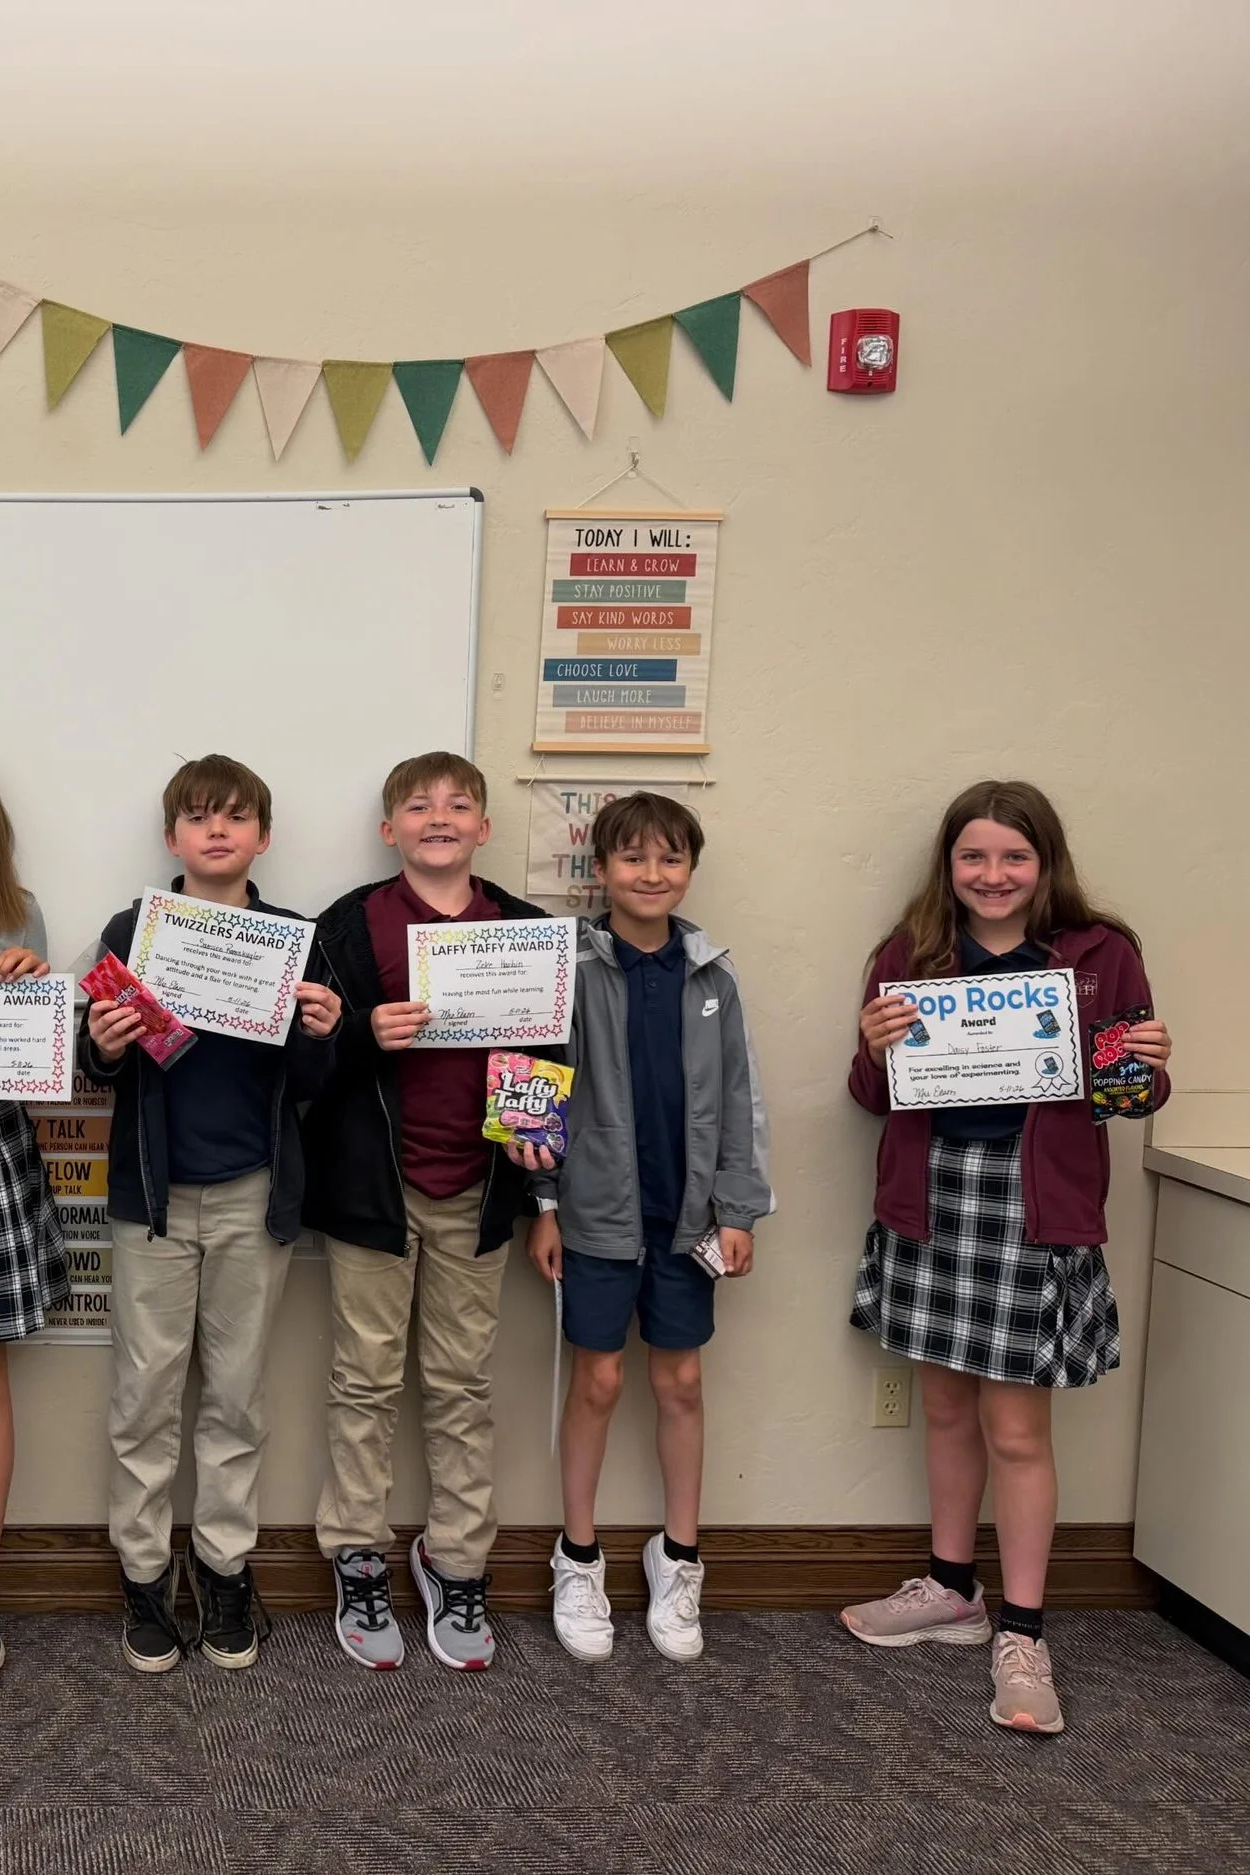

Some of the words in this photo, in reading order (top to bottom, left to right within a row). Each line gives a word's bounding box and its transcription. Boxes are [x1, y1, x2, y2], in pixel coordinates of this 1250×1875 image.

[575, 529, 623, 547] TODAY
[634, 529, 637, 547] I
[649, 529, 691, 548] WILL:
[587, 559, 625, 572] LEARN
[630, 559, 637, 572] &
[644, 559, 679, 572] GROW
[574, 585, 604, 599] STAY
[610, 585, 661, 598] POSITIVE
[572, 612, 593, 624] SAY
[599, 612, 625, 625] KIND
[632, 612, 674, 625] WORDS
[607, 637, 647, 650] WORRY
[654, 637, 682, 650] LESS
[557, 664, 602, 677] CHOOSE
[609, 664, 638, 677] LOVE
[577, 690, 614, 703] LAUGH
[621, 690, 652, 703] MORE
[580, 716, 624, 729] BELIEVE
[632, 716, 642, 729] IN
[648, 716, 691, 729] MYSELF
[164, 913, 233, 938] TWIZZLERS
[235, 931, 285, 949] AWARD
[183, 946, 208, 957] receives
[210, 951, 220, 960] this
[222, 955, 241, 964] award
[432, 944, 467, 956] LAFFY
[470, 943, 505, 954] TAFFY
[509, 941, 553, 952] AWARD
[155, 953, 180, 966] Dancing
[181, 959, 205, 971] through
[206, 966, 220, 975] your
[222, 969, 237, 978] work
[239, 973, 252, 982] with
[258, 978, 276, 987] great
[166, 966, 190, 977] attitude
[191, 972, 202, 980] and
[3, 995, 51, 1005] AWARD
[162, 990, 182, 999] signed
[966, 982, 1059, 1012] Rocks
[235, 1007, 249, 1015] date
[961, 1017, 996, 1028] Award
[925, 1064, 960, 1073] excelling
[500, 1071, 557, 1099] Laffy
[1093, 1077, 1126, 1086] POPPING
[1128, 1074, 1151, 1084] CANDY
[495, 1089, 547, 1115] Taffy
[47, 1120, 85, 1138] TALK
[50, 1143, 73, 1151] PERSON
[74, 1143, 87, 1151] CAN
[90, 1143, 103, 1151] HEAR
[46, 1162, 91, 1180] FLOW
[65, 1186, 81, 1194] TALK
[81, 1231, 100, 1239] VOICE
[84, 1275, 99, 1283] HEAR
